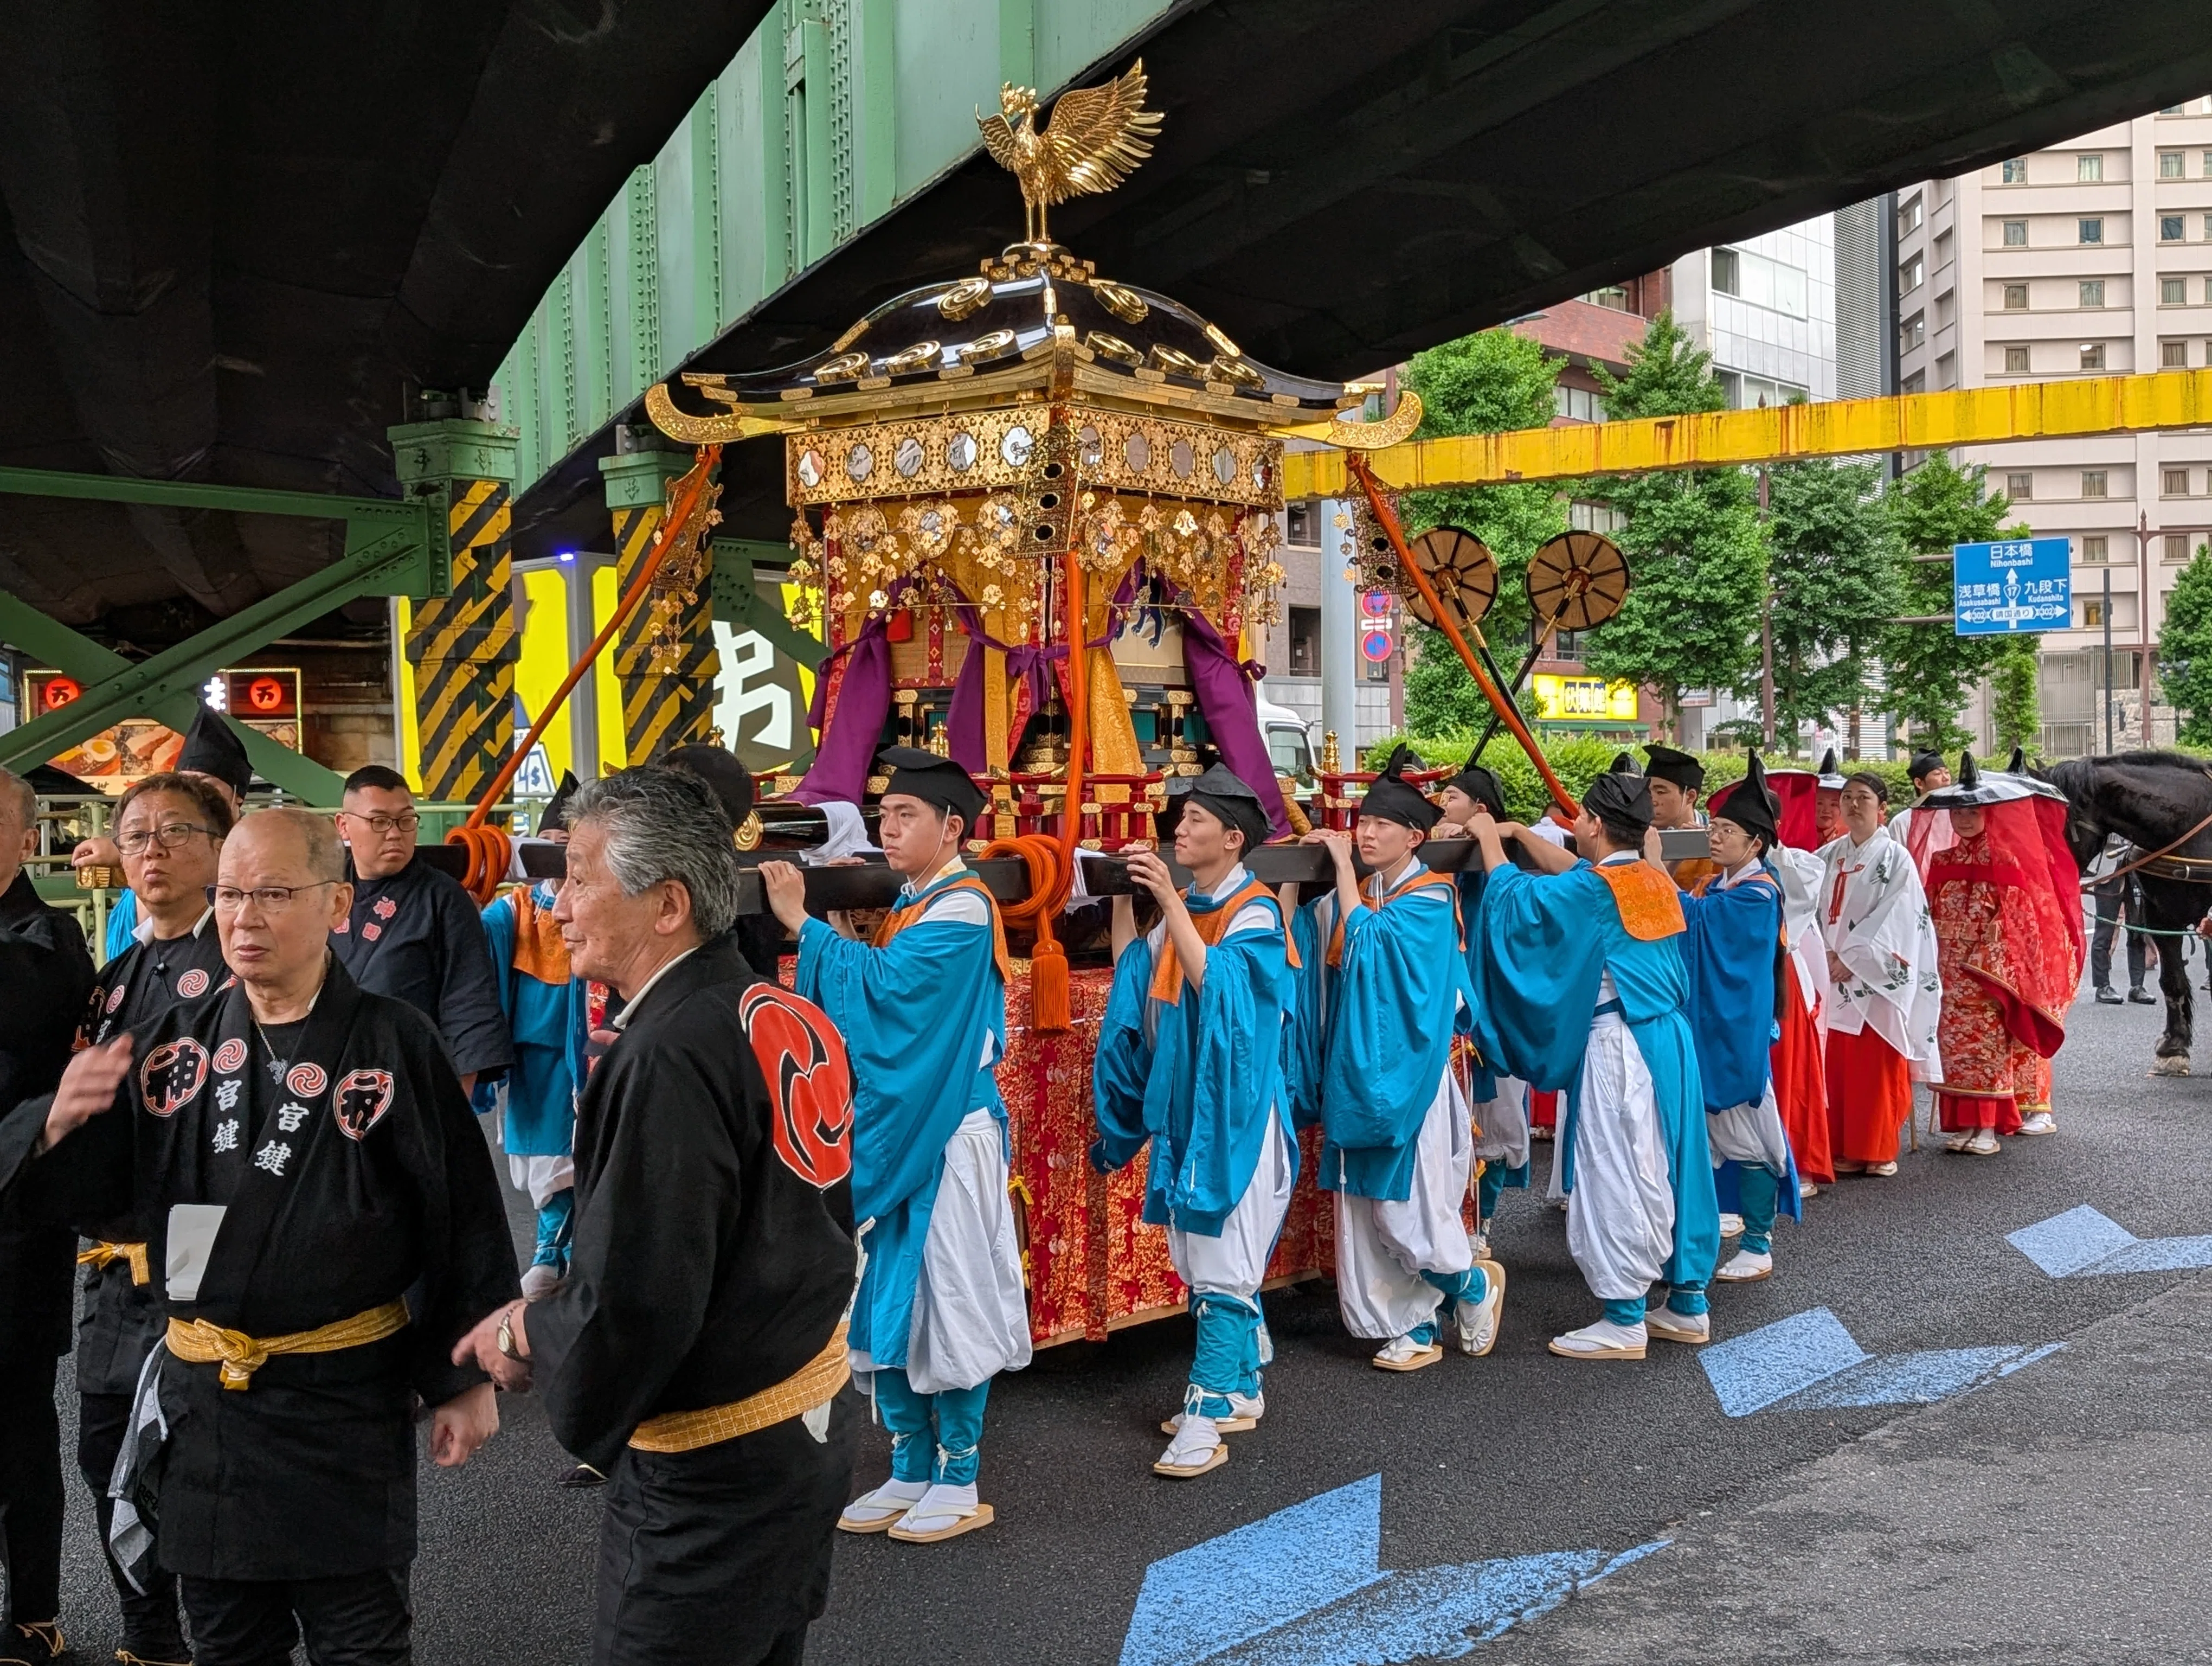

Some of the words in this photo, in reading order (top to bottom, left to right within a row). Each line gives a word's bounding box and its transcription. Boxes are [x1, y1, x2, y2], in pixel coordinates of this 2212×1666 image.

[1990, 543, 2033, 559] 日本橋
[1990, 558, 2033, 568] Nihonbashi
[1958, 583, 2001, 598] 浅草橋
[2007, 586, 2017, 597] 17
[2024, 578, 2067, 595] 九段下
[1958, 597, 2001, 607] Asakusabashi
[2028, 594, 2063, 603] Kudanshita
[52, 685, 70, 703] 万
[255, 684, 275, 704] 万
[212, 1080, 242, 1154] 宮鍵
[254, 1101, 310, 1176] 宮鍵
